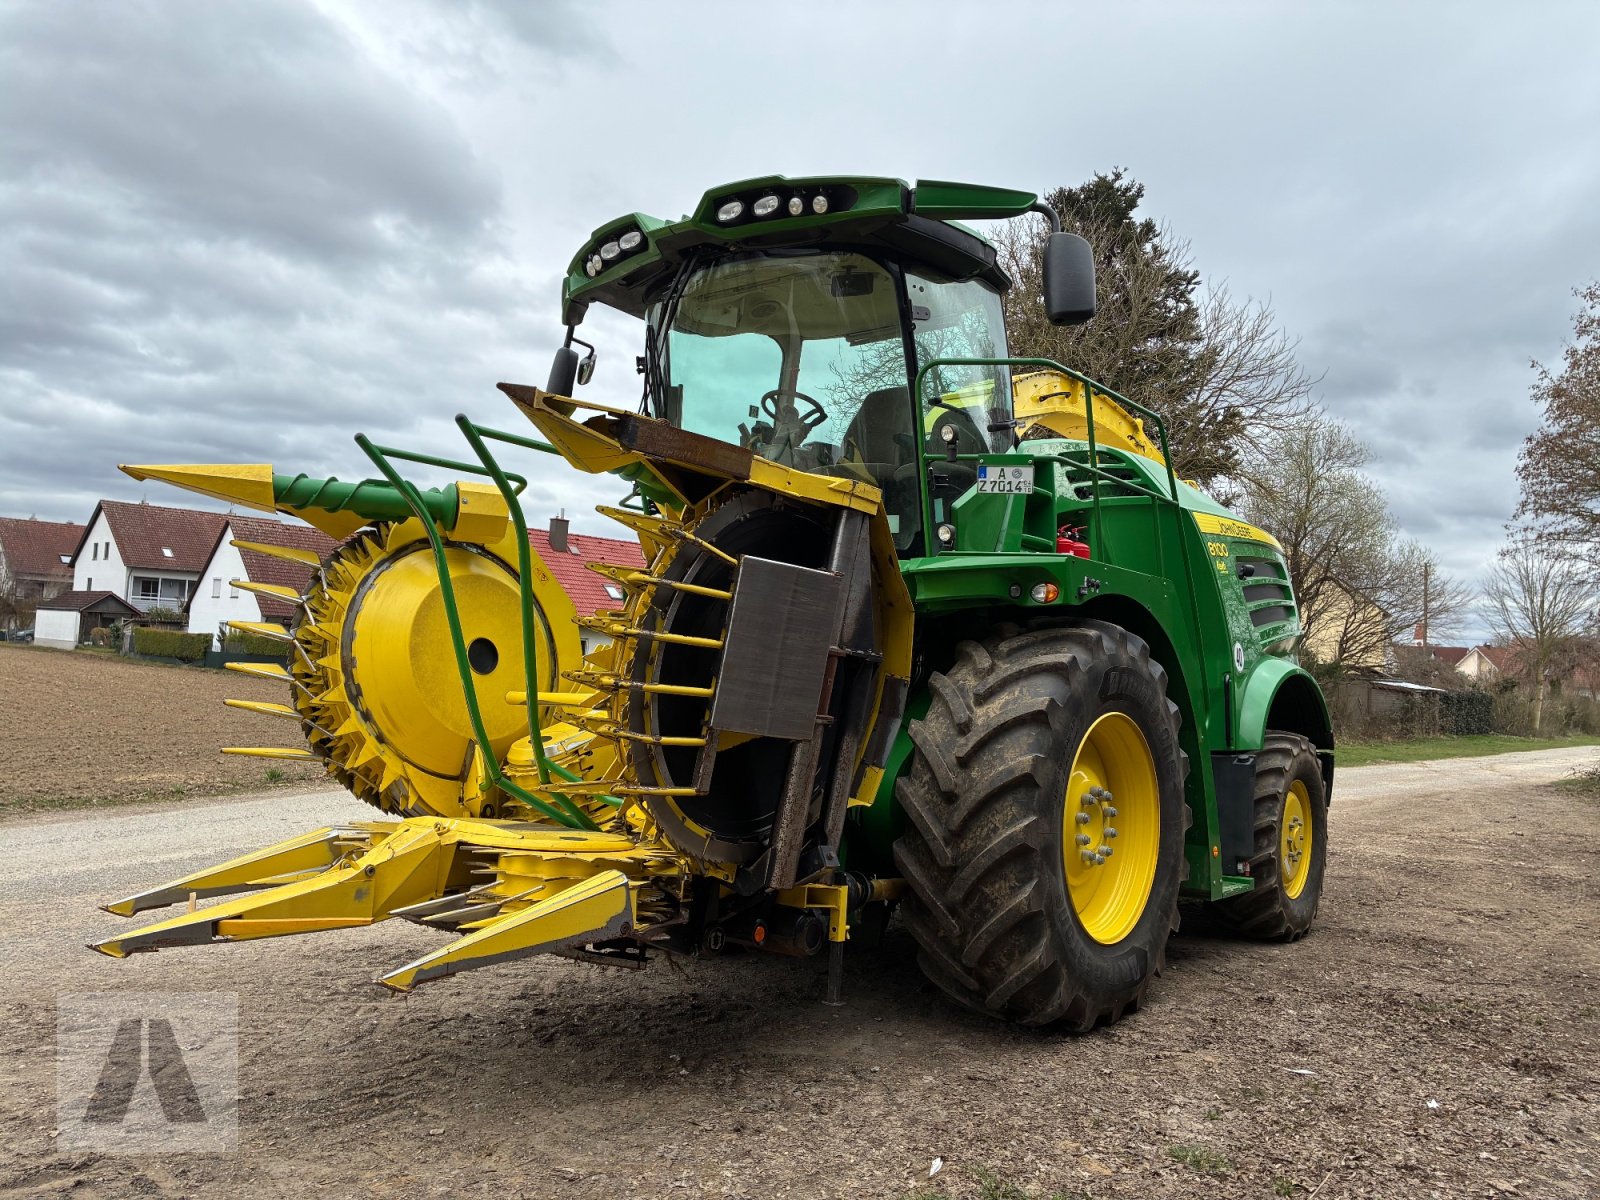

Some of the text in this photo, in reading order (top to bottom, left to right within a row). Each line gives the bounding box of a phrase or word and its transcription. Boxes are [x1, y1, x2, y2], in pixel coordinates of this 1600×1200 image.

[998, 468, 1006, 479] A
[979, 480, 1022, 492] Z 7014
[1207, 541, 1228, 557] 8100
